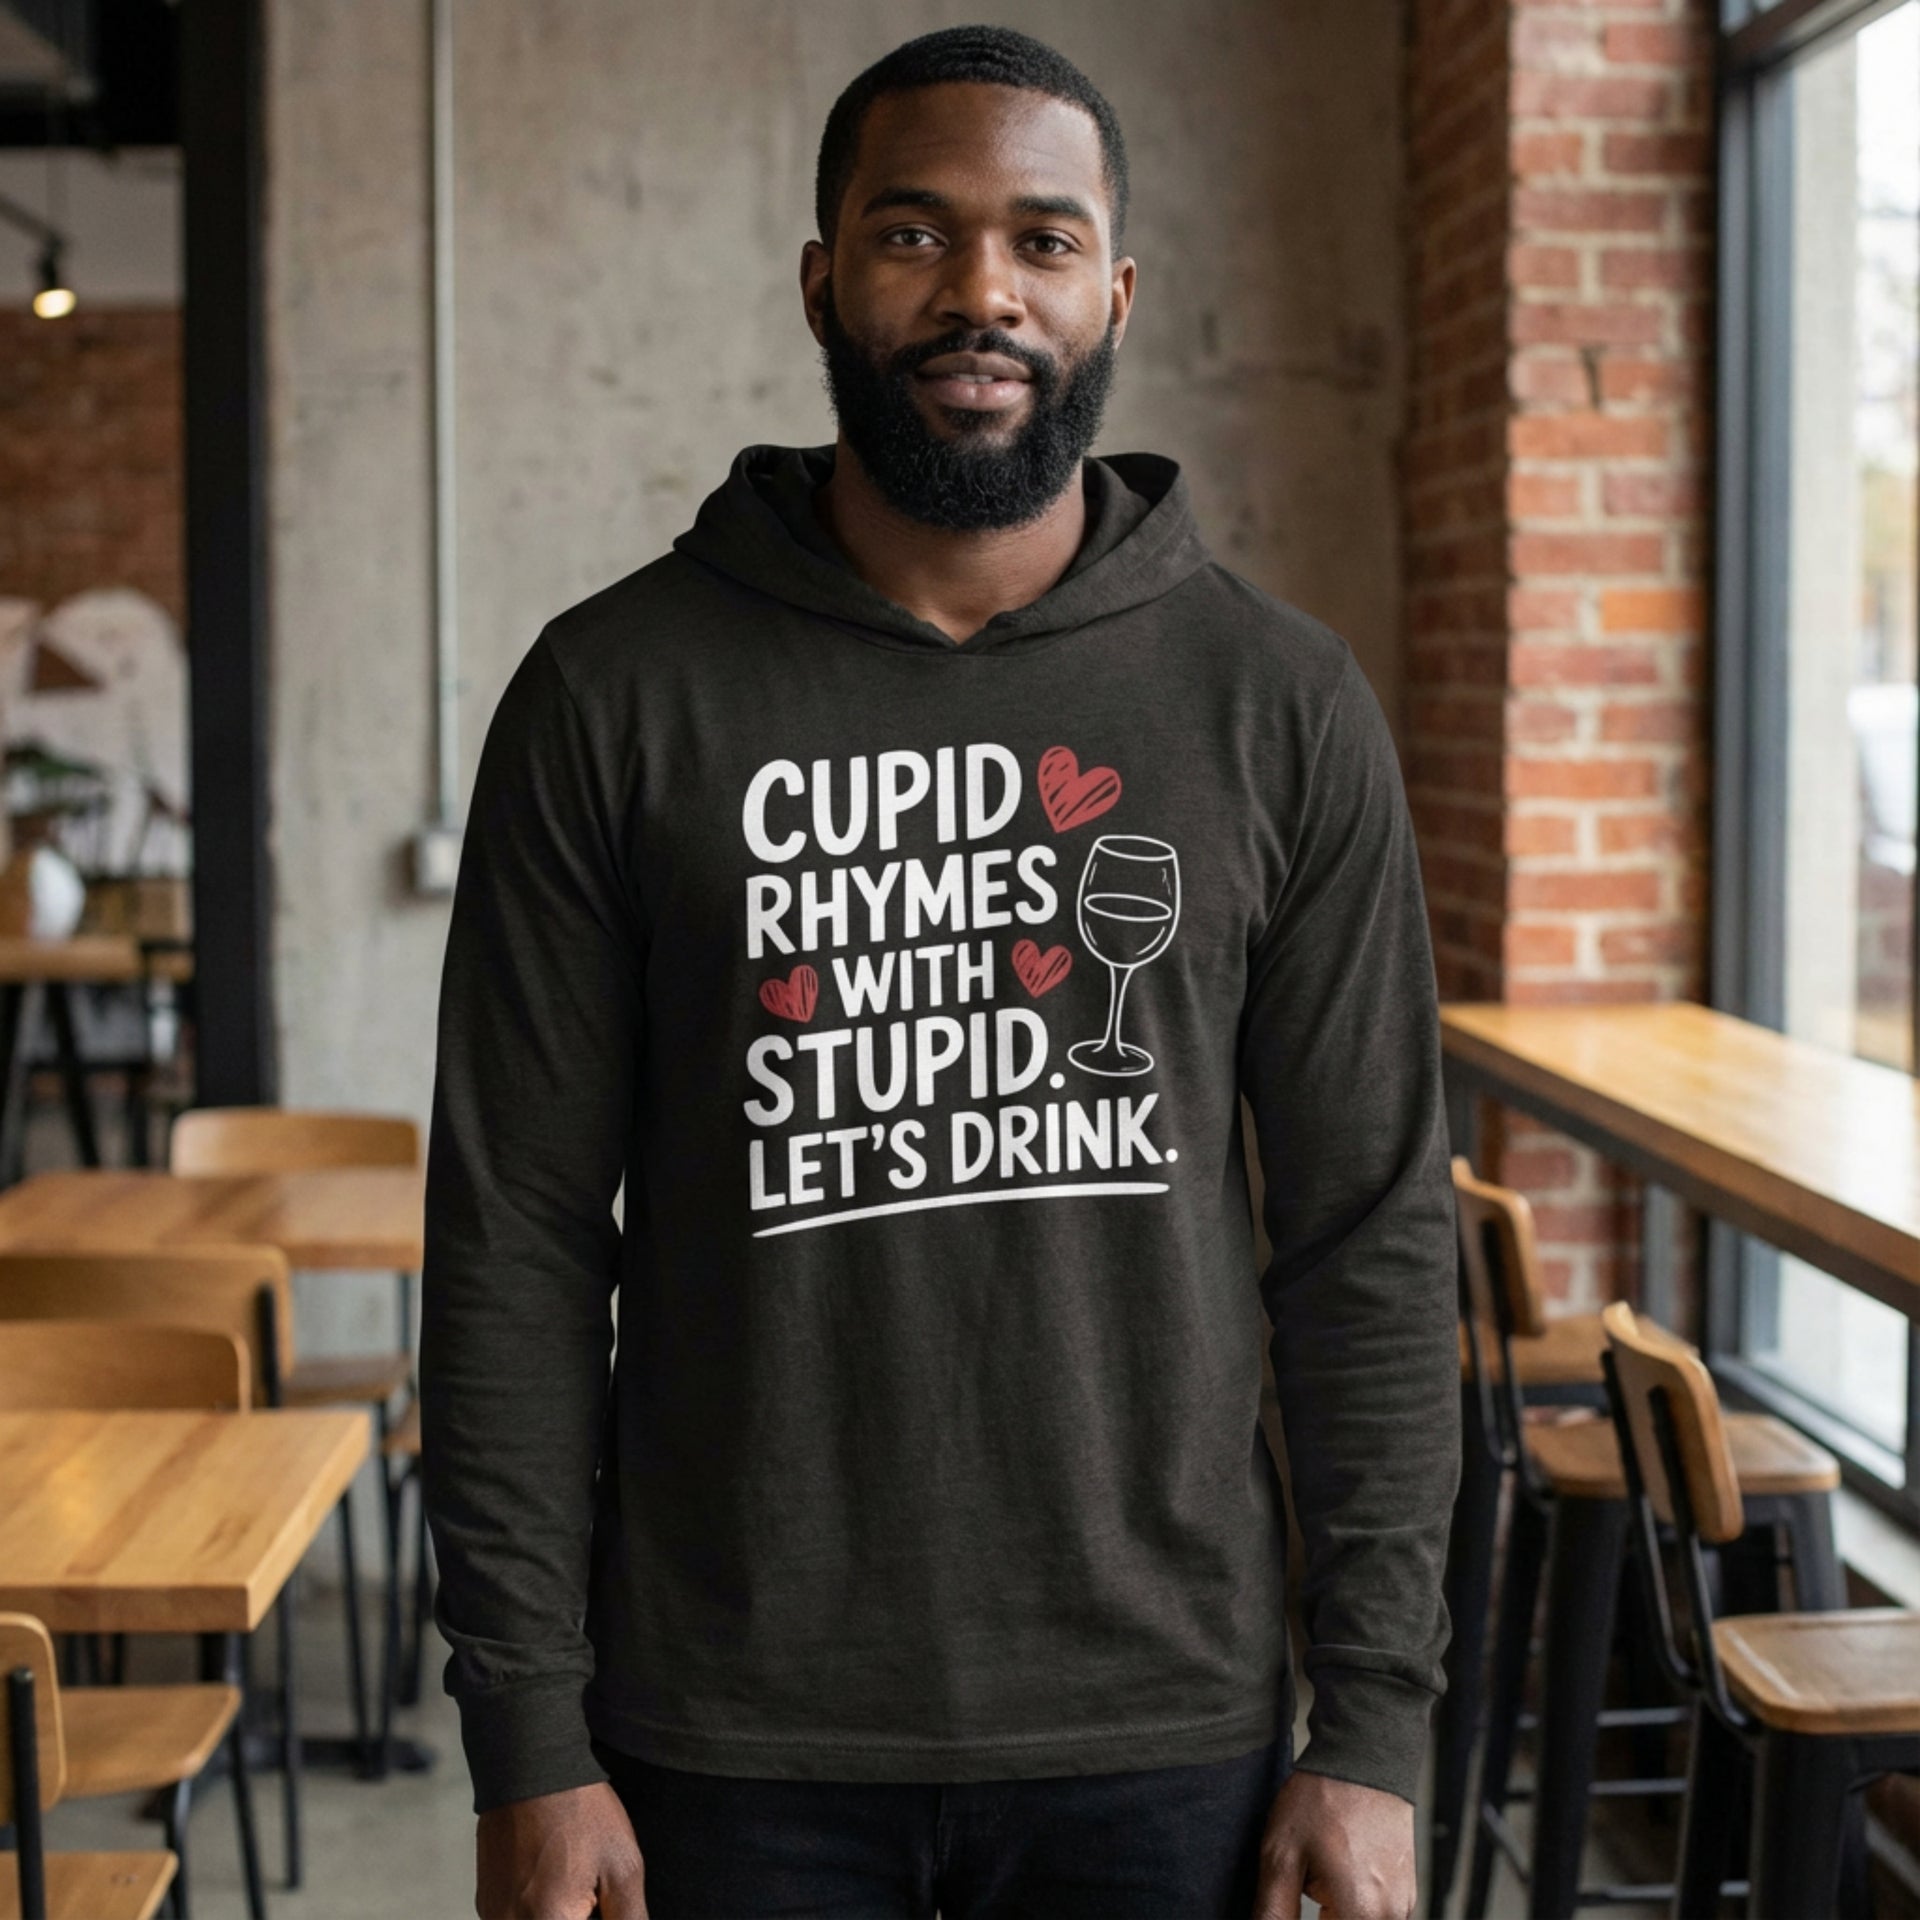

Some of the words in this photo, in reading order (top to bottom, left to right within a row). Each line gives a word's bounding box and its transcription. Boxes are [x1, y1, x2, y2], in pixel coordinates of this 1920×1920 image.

[742, 743, 1023, 864] CUPID
[746, 845, 1058, 959] RHYMES
[831, 940, 994, 1018] WITH
[743, 1007, 1066, 1126] STUPID.
[749, 1119, 928, 1211] LET'S
[951, 1092, 1179, 1184] DRINK.
